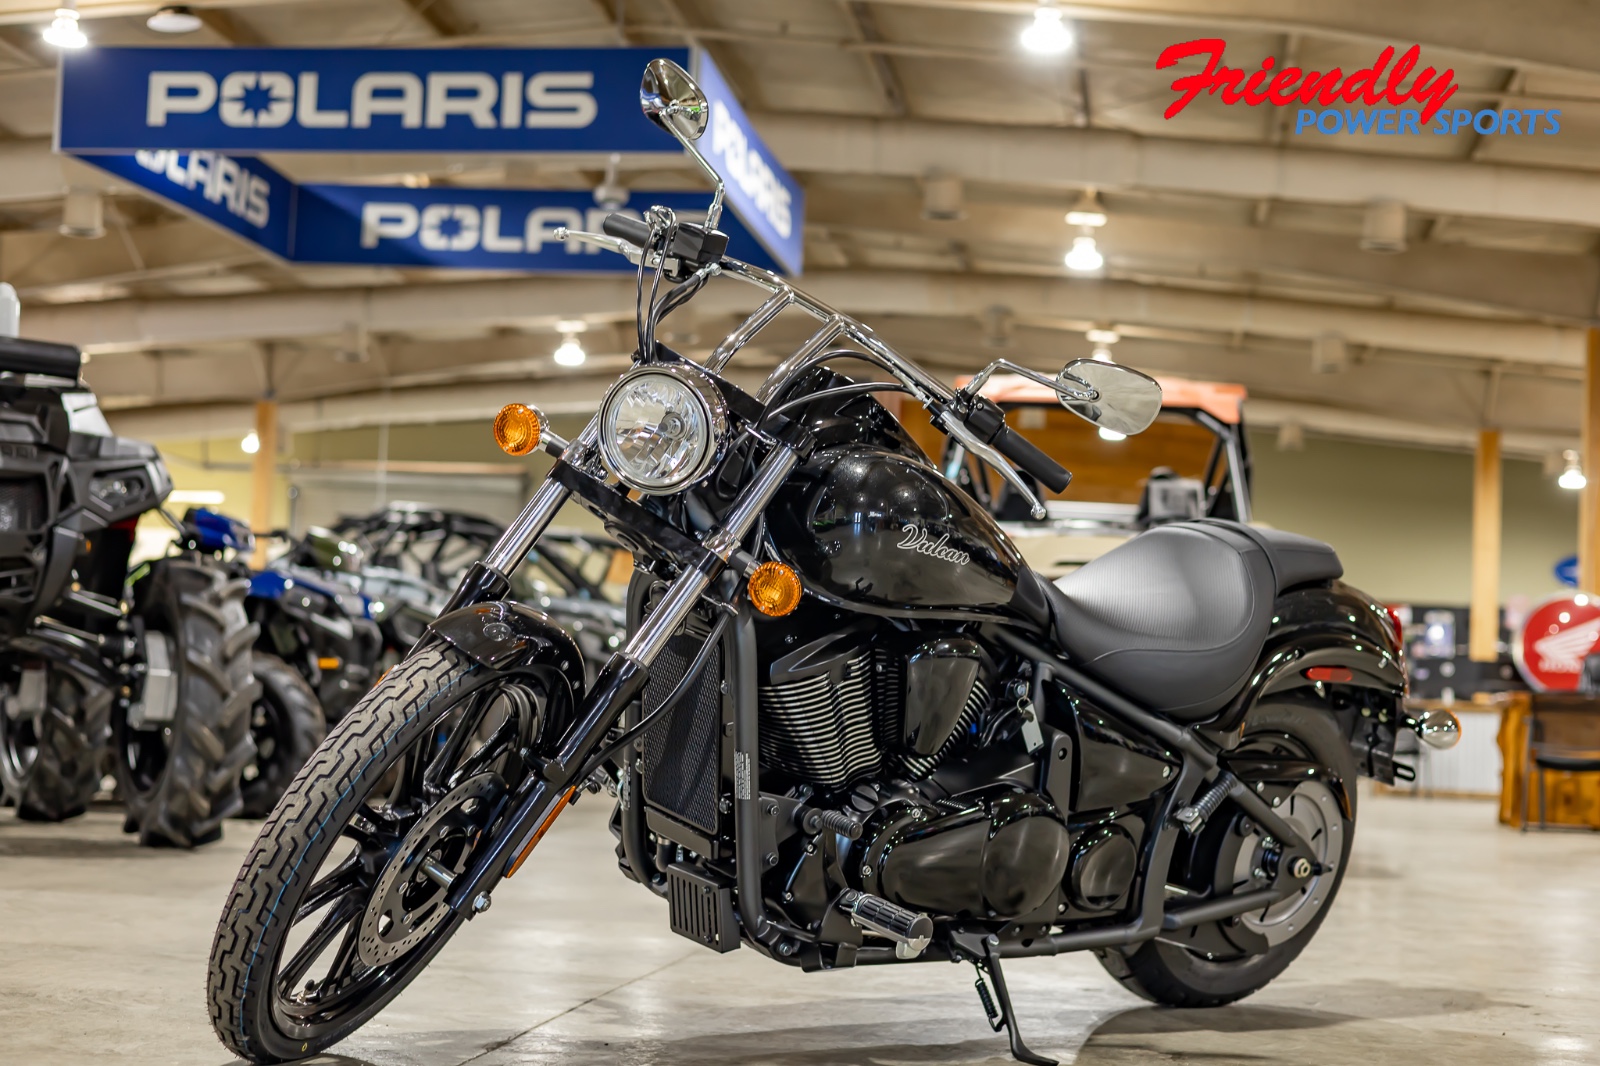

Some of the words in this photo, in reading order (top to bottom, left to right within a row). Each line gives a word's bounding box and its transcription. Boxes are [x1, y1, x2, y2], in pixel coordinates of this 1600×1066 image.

[147, 70, 598, 129] POLARIS
[134, 150, 271, 229] OLARIS
[361, 202, 708, 255] POLA
[897, 523, 970, 565] Vulcan
